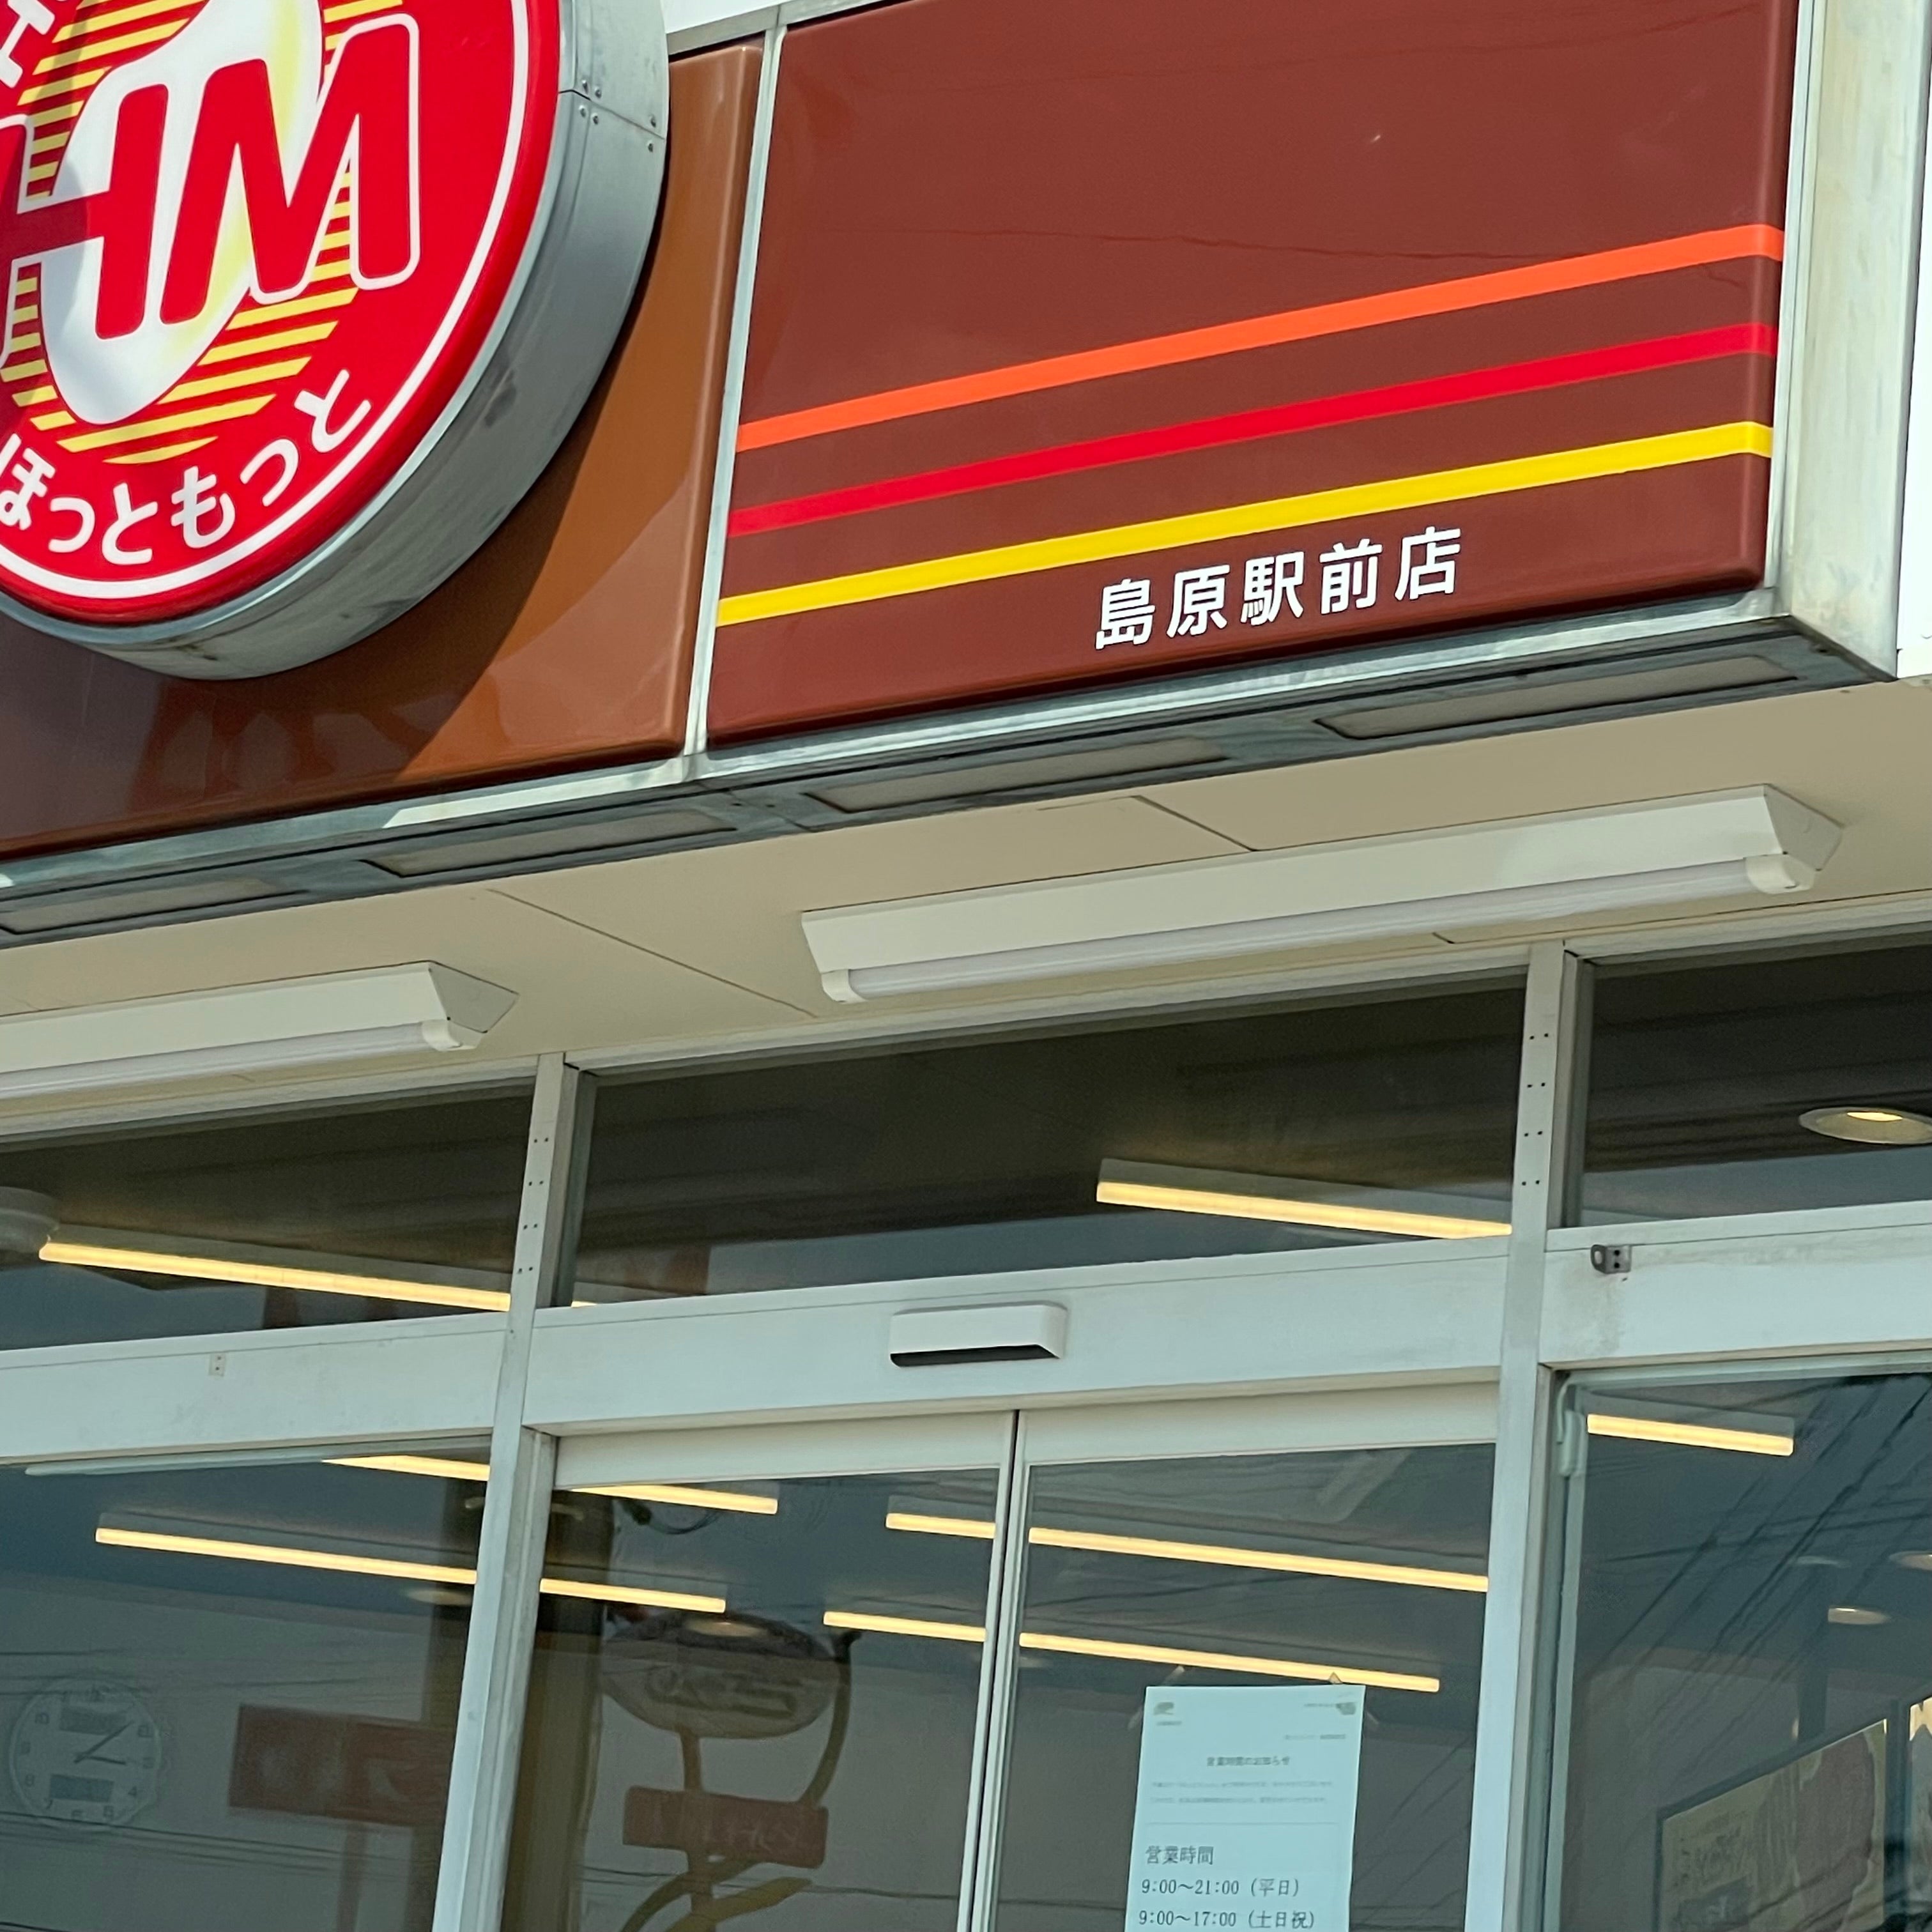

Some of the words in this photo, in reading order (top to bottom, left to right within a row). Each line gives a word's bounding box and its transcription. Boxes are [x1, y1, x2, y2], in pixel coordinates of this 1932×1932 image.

[1094, 526, 1462, 650] 島原駅前店
[1146, 1845, 1214, 1865] 営業時間
